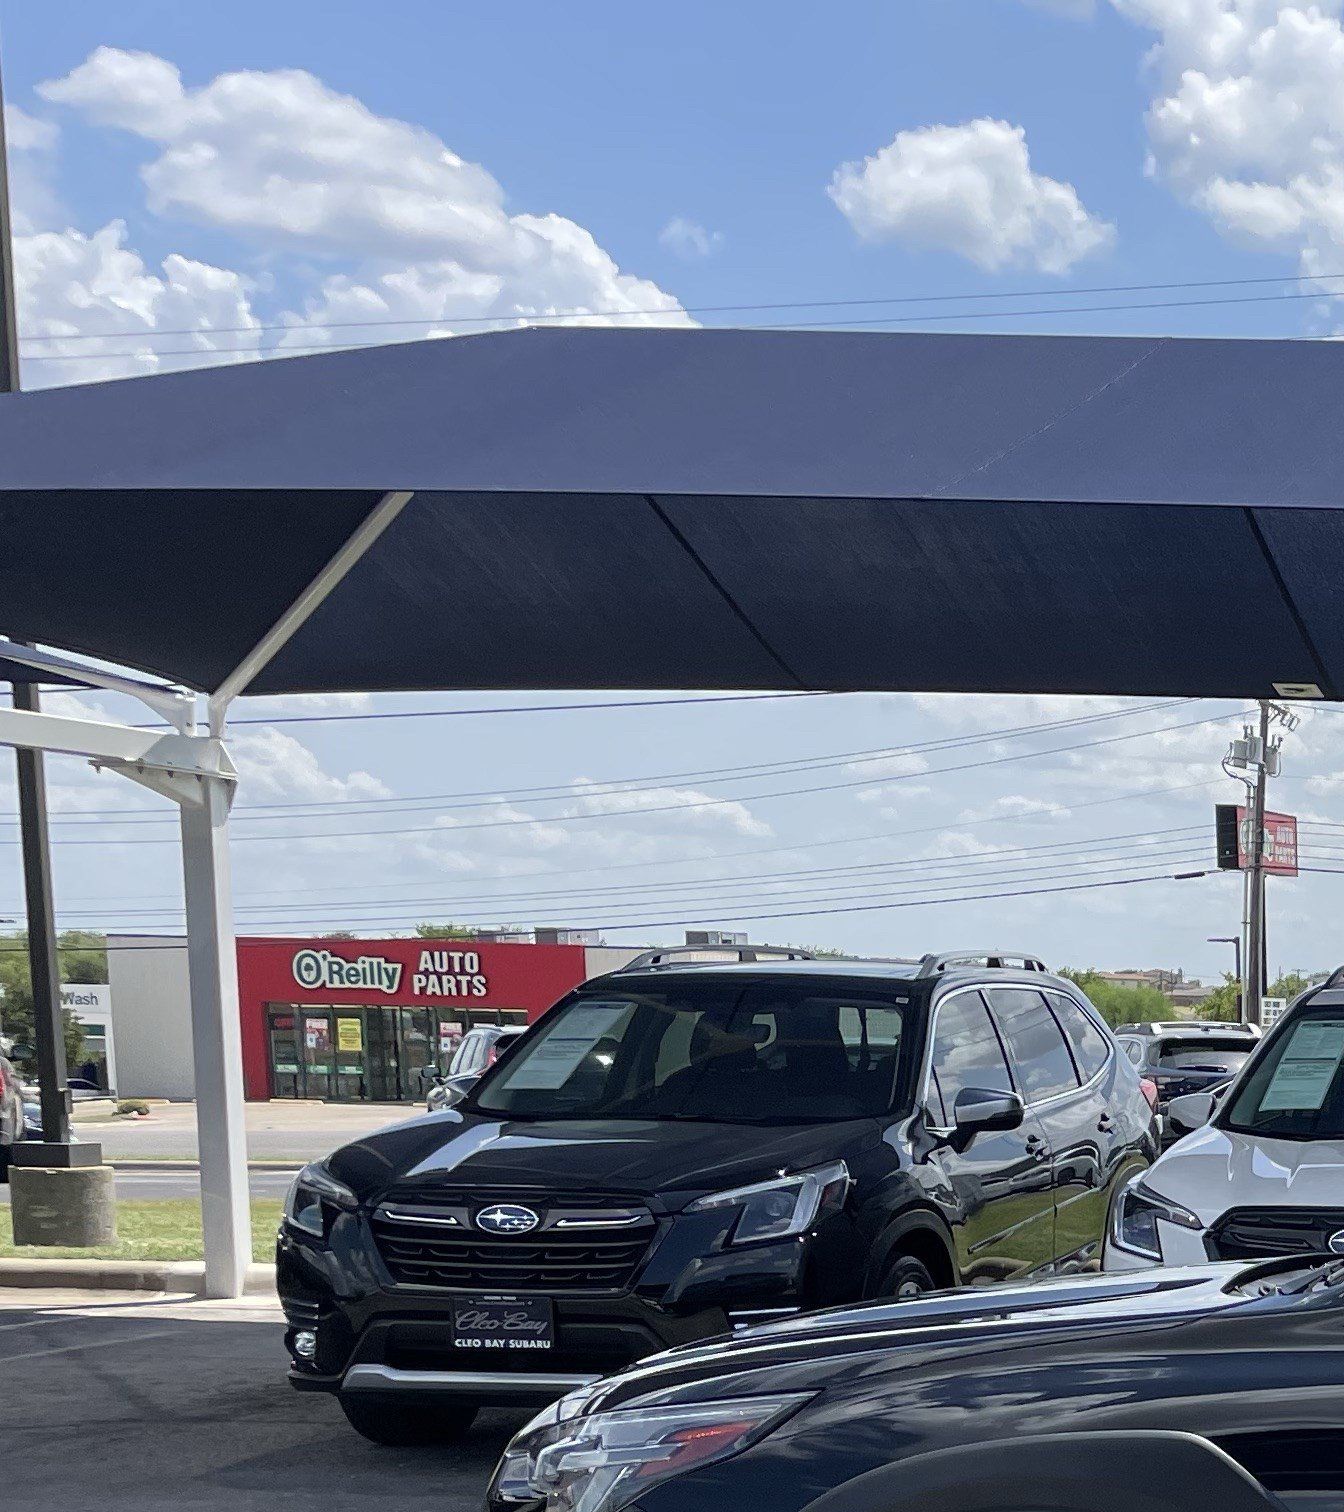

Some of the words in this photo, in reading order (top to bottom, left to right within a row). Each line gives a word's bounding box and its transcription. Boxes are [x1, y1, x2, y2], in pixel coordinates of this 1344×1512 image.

[294, 951, 400, 992] O'Reilly
[419, 951, 479, 973] AUTO
[413, 974, 487, 997] PARTS
[454, 1339, 482, 1348] CLEO
[485, 1339, 506, 1348] BAY
[509, 1340, 551, 1349] SUBARU
